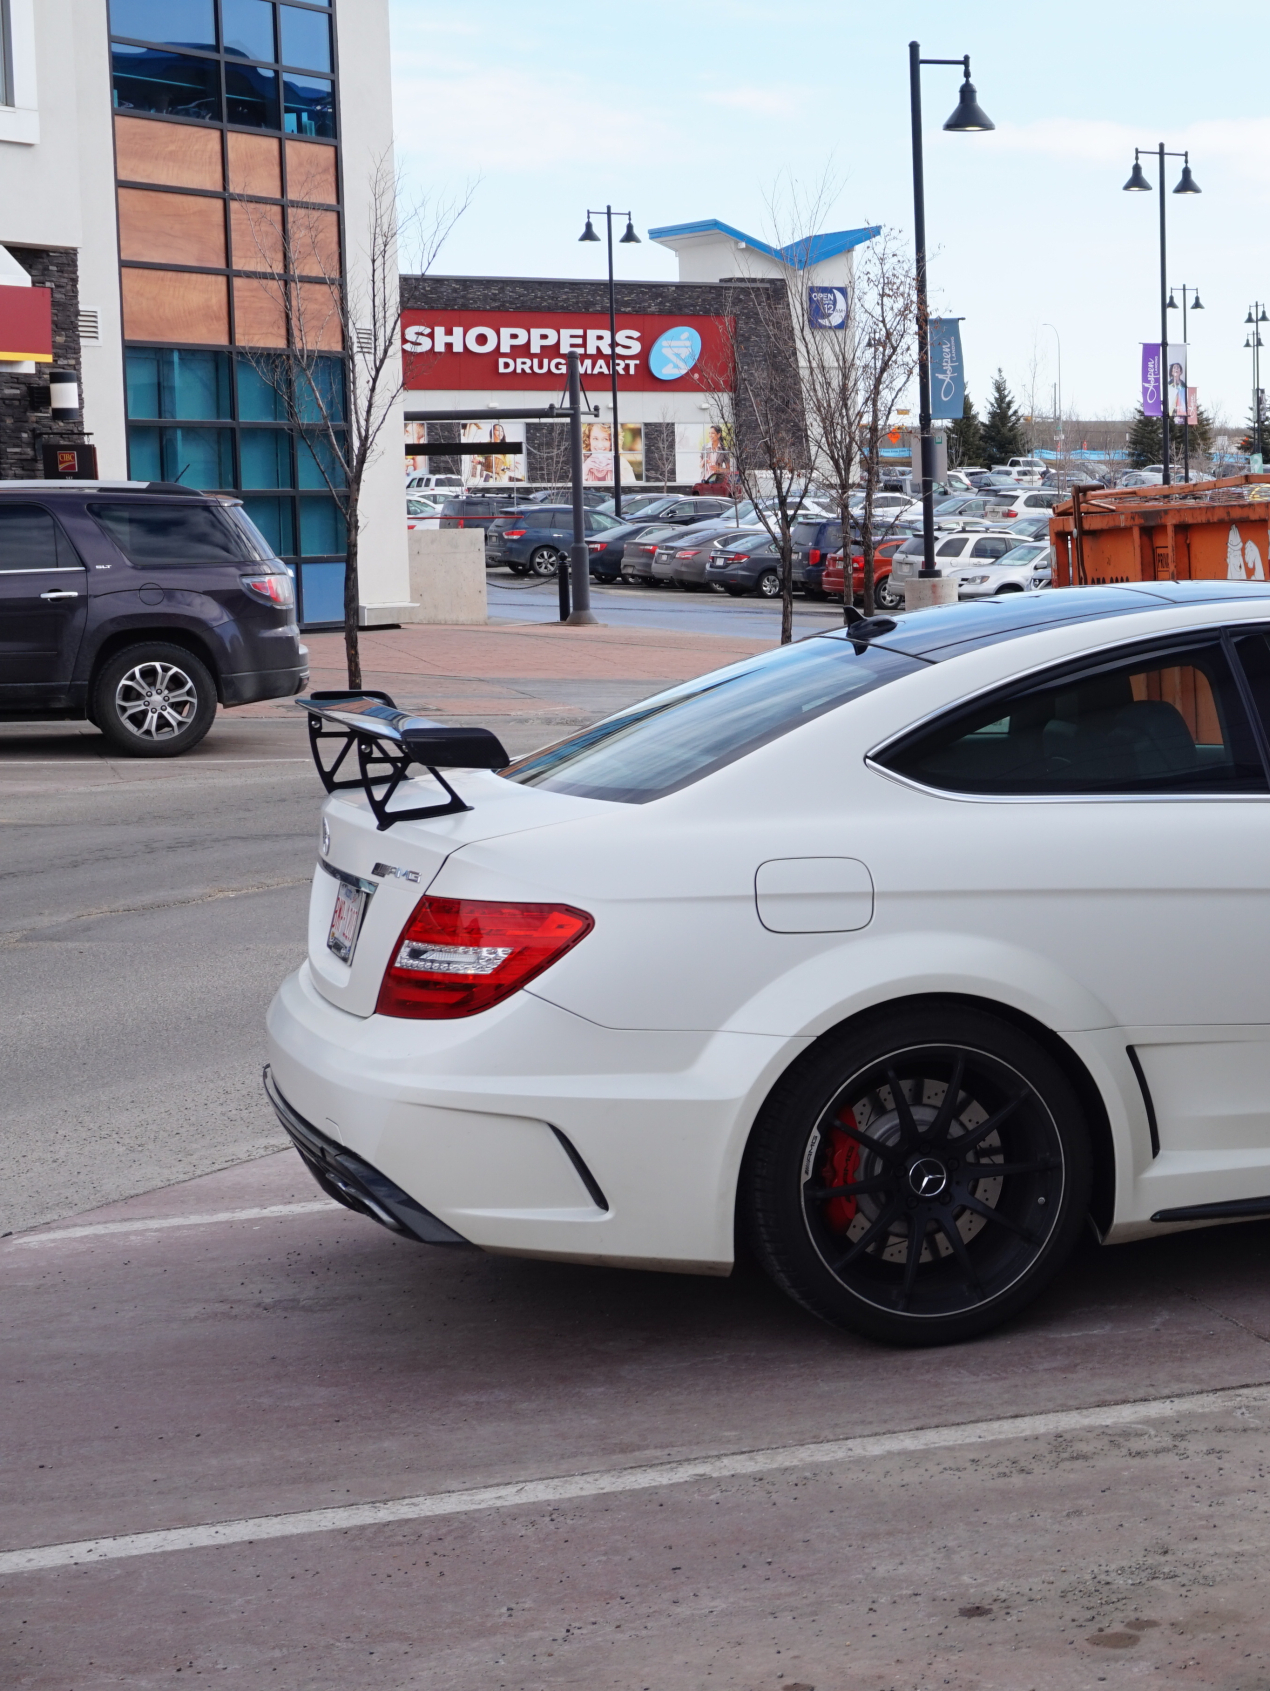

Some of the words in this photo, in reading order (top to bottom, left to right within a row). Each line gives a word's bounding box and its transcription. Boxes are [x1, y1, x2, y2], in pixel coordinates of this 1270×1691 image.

[812, 293, 834, 301] OPEN
[824, 304, 834, 314] 12
[401, 325, 642, 356] SHOPPERS
[498, 358, 567, 375] DRUG
[576, 359, 640, 376] MART
[935, 338, 959, 401] Aspen
[1142, 358, 1160, 404] Aspen
[59, 453, 75, 462] CIBC
